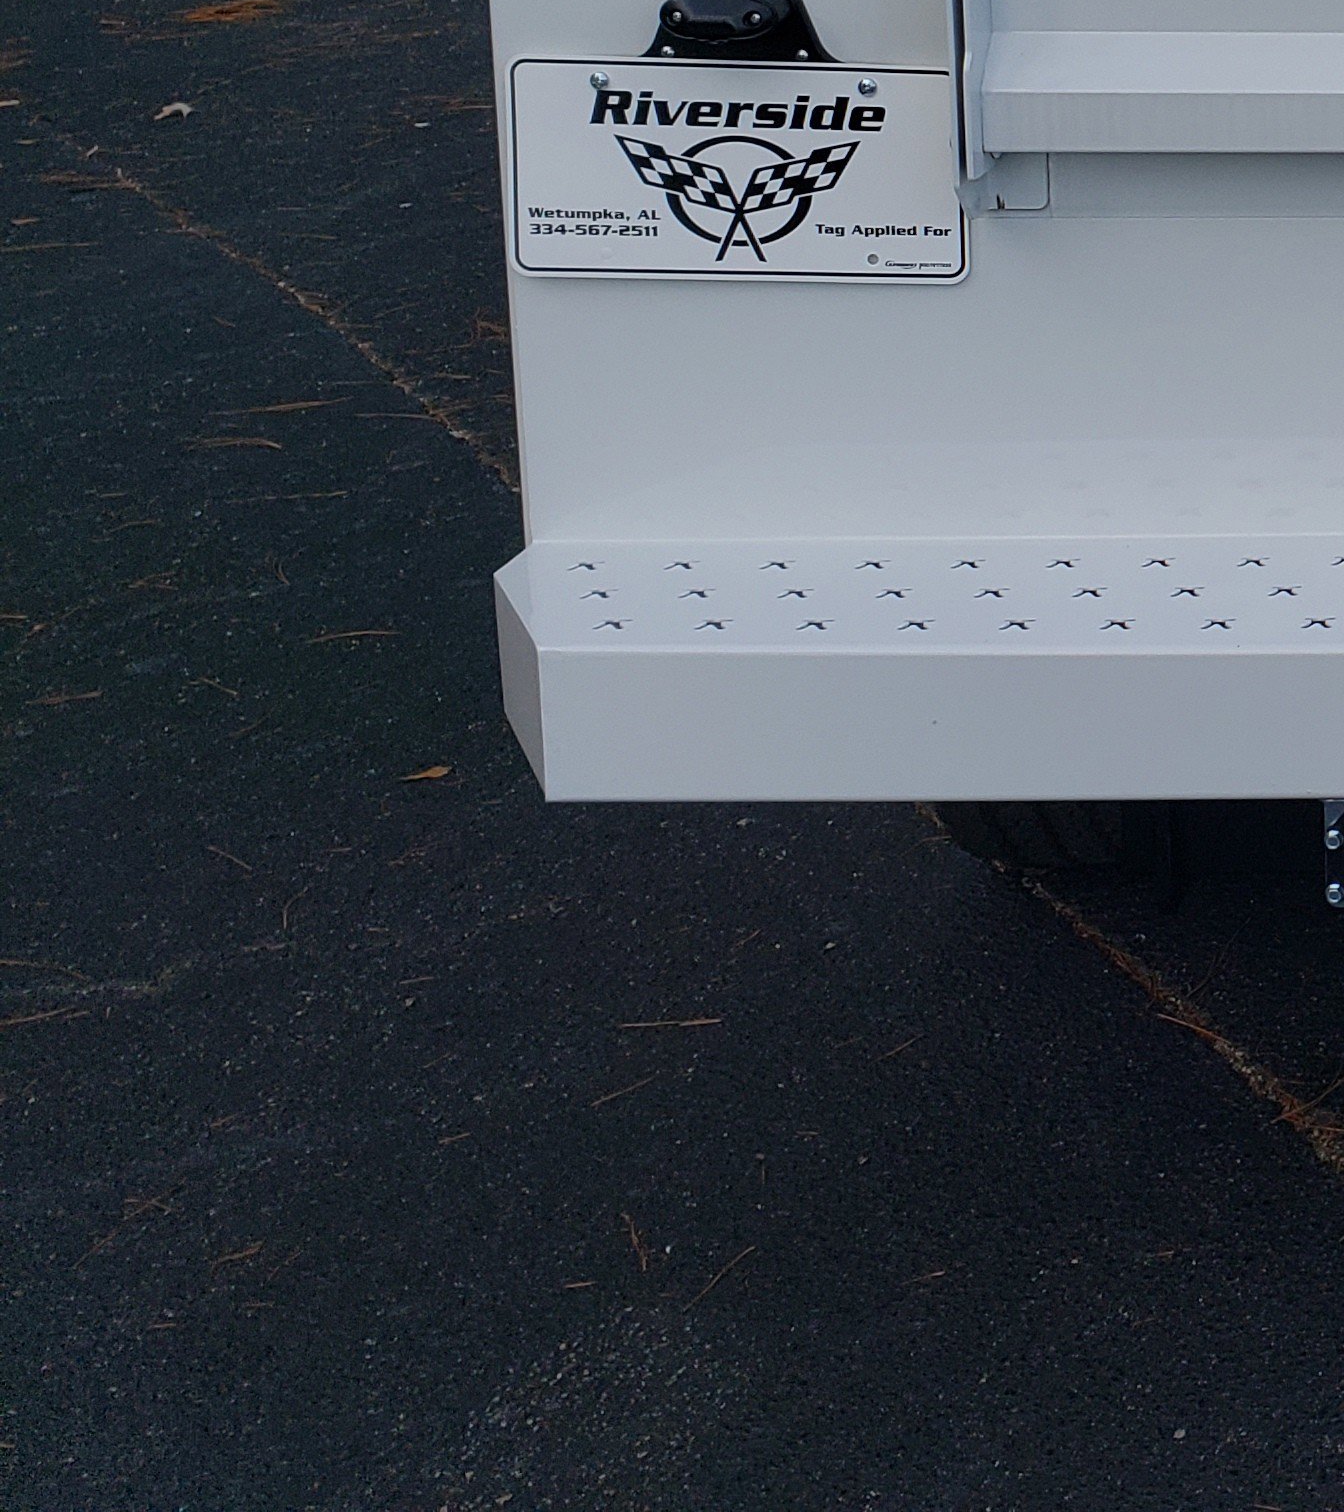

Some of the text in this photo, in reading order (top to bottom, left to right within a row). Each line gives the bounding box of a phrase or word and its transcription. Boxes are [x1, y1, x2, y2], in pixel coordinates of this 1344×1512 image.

[589, 89, 886, 132] Riverside
[528, 207, 662, 221] Wetumpka, AL
[529, 223, 658, 237] 334-567-2511
[815, 224, 952, 238] Tag Applied For
